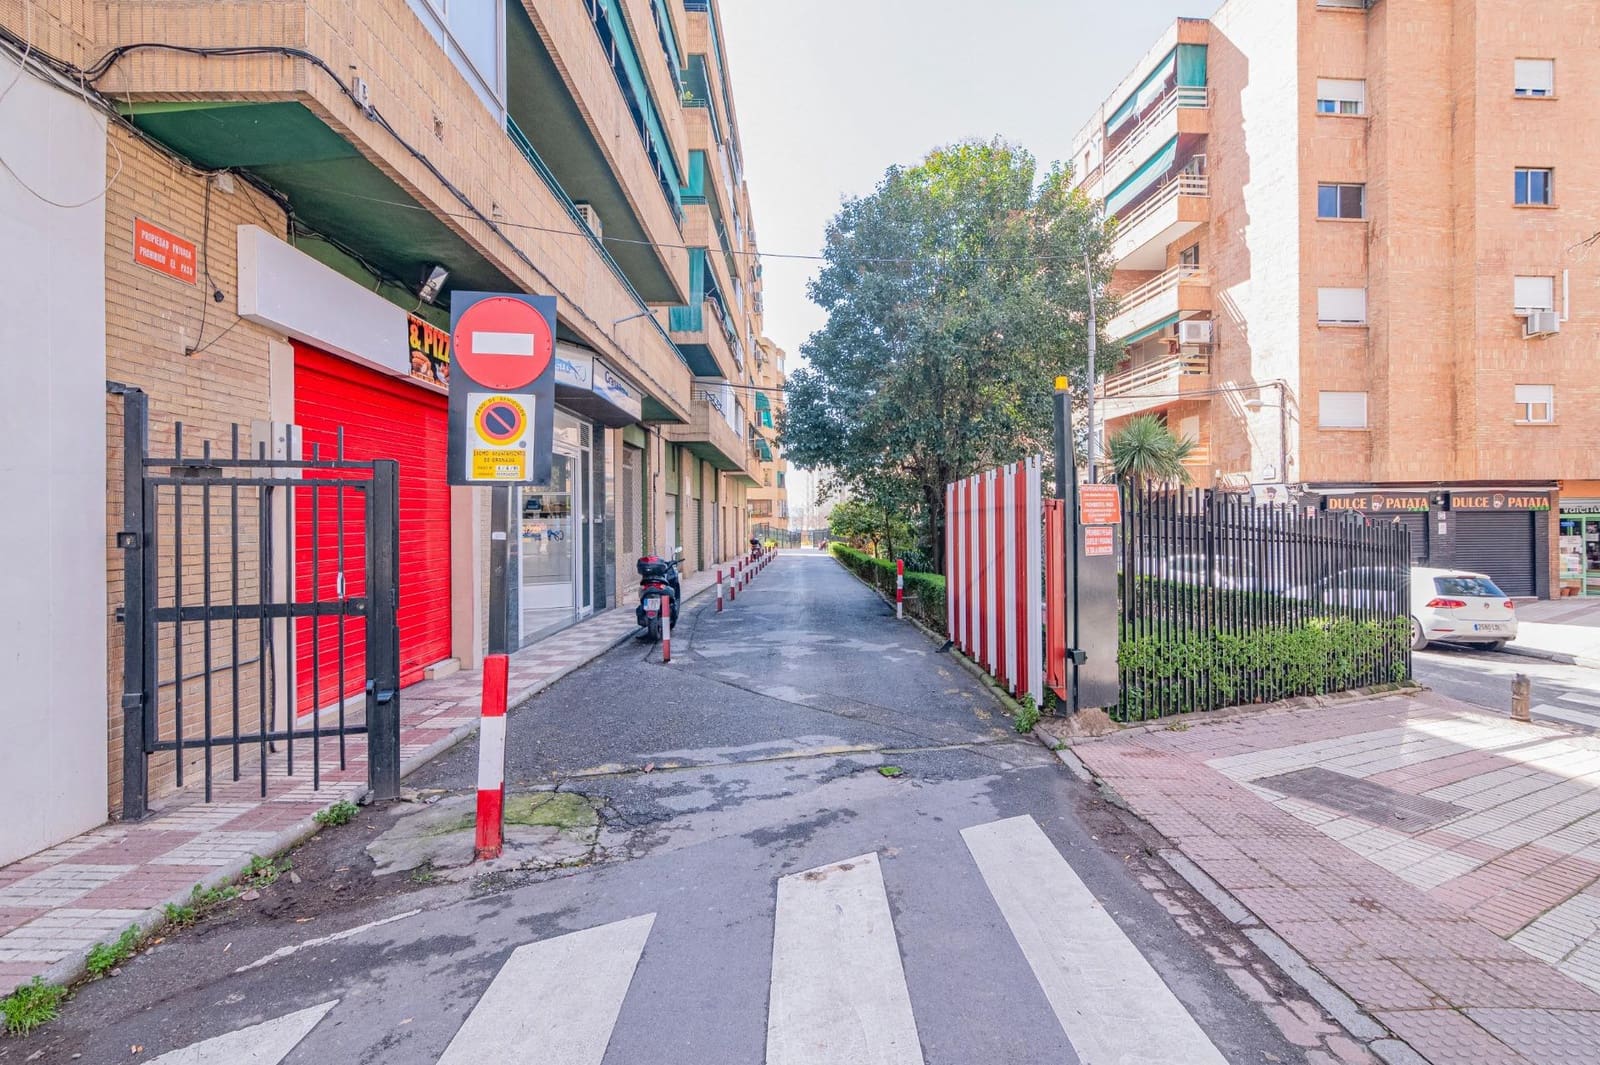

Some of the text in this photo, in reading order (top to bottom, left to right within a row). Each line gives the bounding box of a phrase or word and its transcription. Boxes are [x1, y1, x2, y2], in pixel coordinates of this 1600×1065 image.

[141, 230, 192, 260] PROPIEDAD PRIVADA
[139, 246, 193, 276] PROHIBIDO EL PASO
[410, 323, 421, 351] &
[1329, 497, 1368, 510] DULCE
[1386, 497, 1428, 509] PATATA
[1452, 496, 1550, 508] DULCE PATATA
